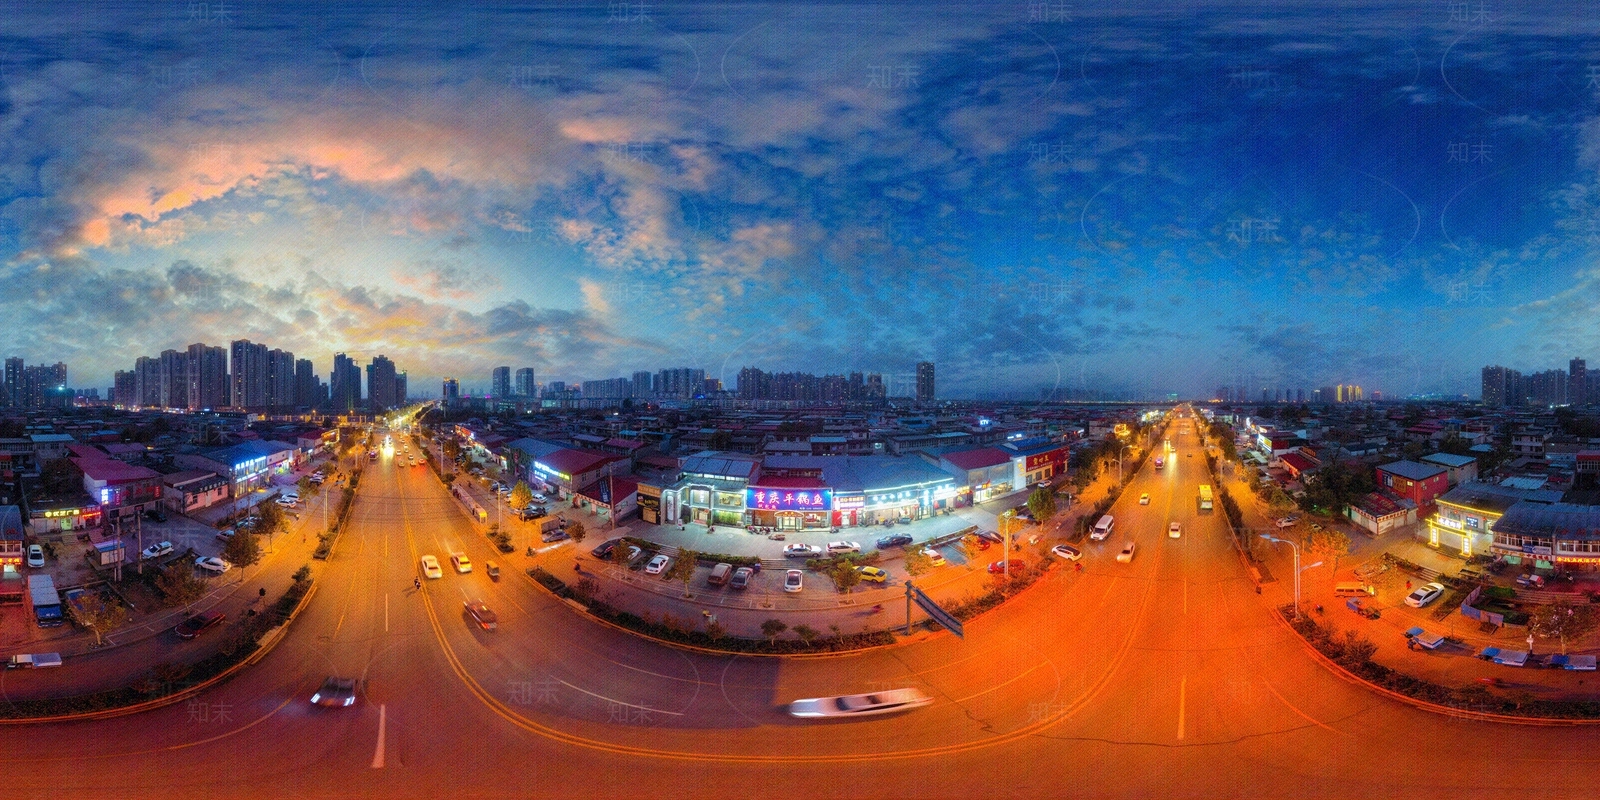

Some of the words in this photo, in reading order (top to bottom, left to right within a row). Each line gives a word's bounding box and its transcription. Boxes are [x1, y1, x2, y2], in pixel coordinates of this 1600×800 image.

[754, 491, 824, 506] 重庆平锅鱼
